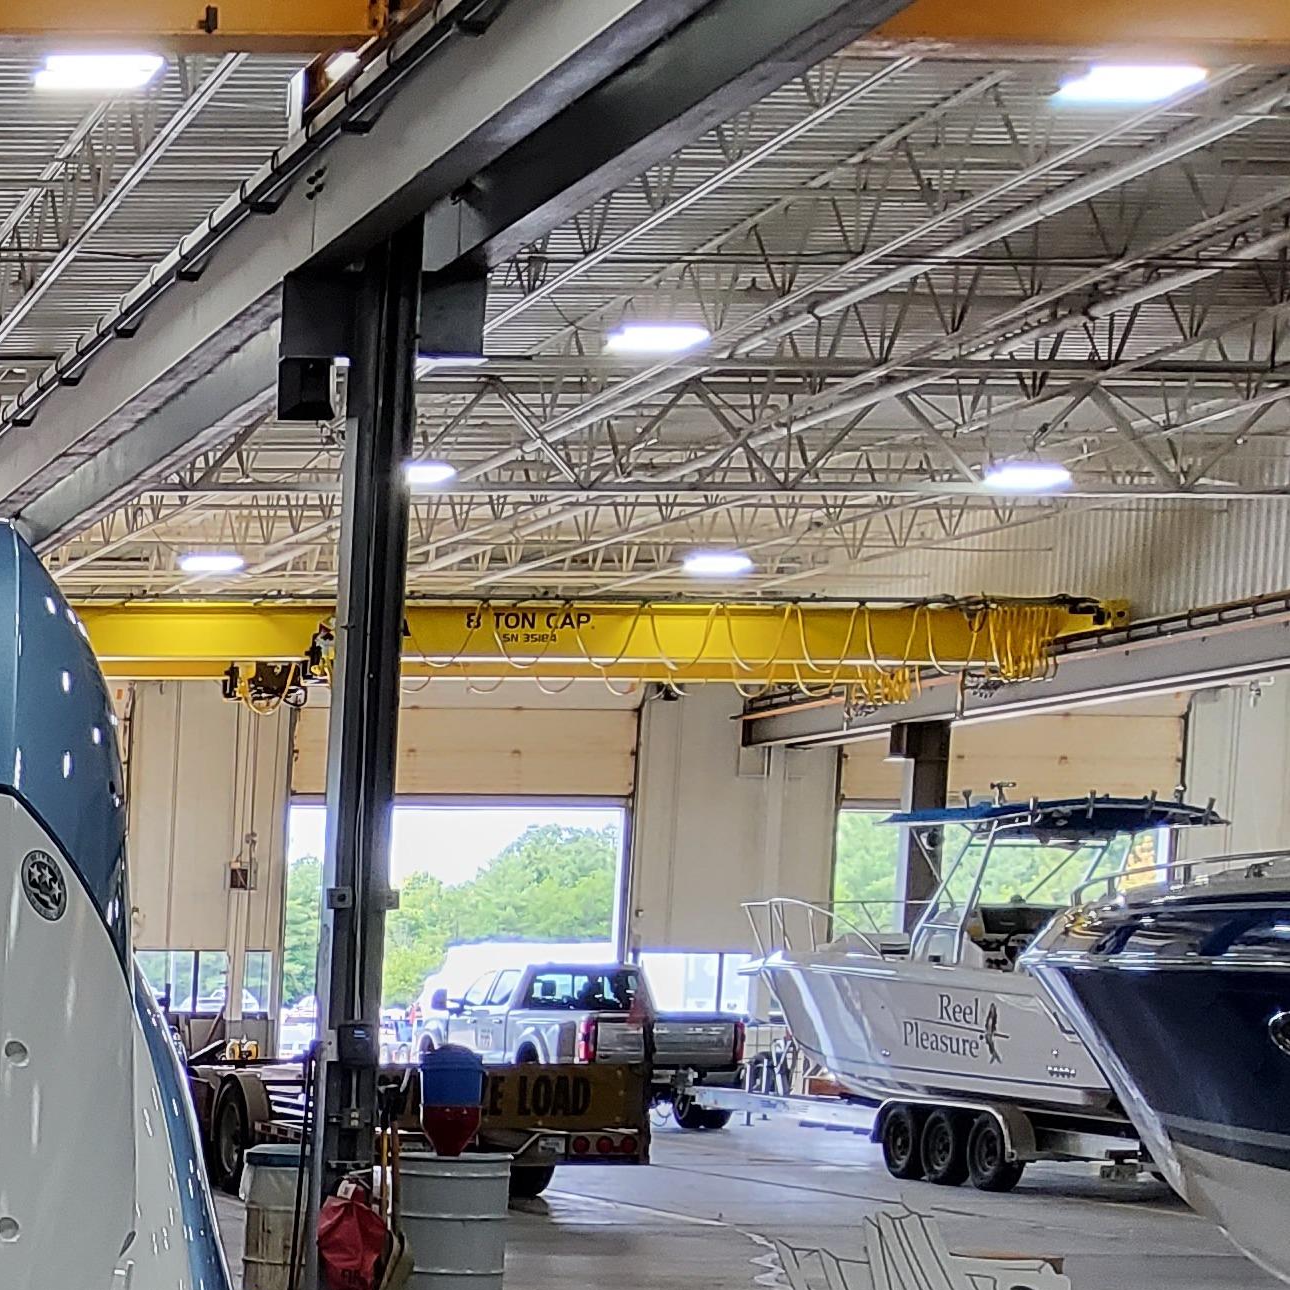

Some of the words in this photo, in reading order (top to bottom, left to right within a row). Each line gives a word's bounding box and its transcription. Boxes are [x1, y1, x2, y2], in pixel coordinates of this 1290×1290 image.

[494, 612, 536, 629] TON
[502, 633, 519, 643] SN
[939, 994, 980, 1025] Reel
[903, 1020, 980, 1059] Pleasure
[519, 1074, 592, 1117] LOAD
